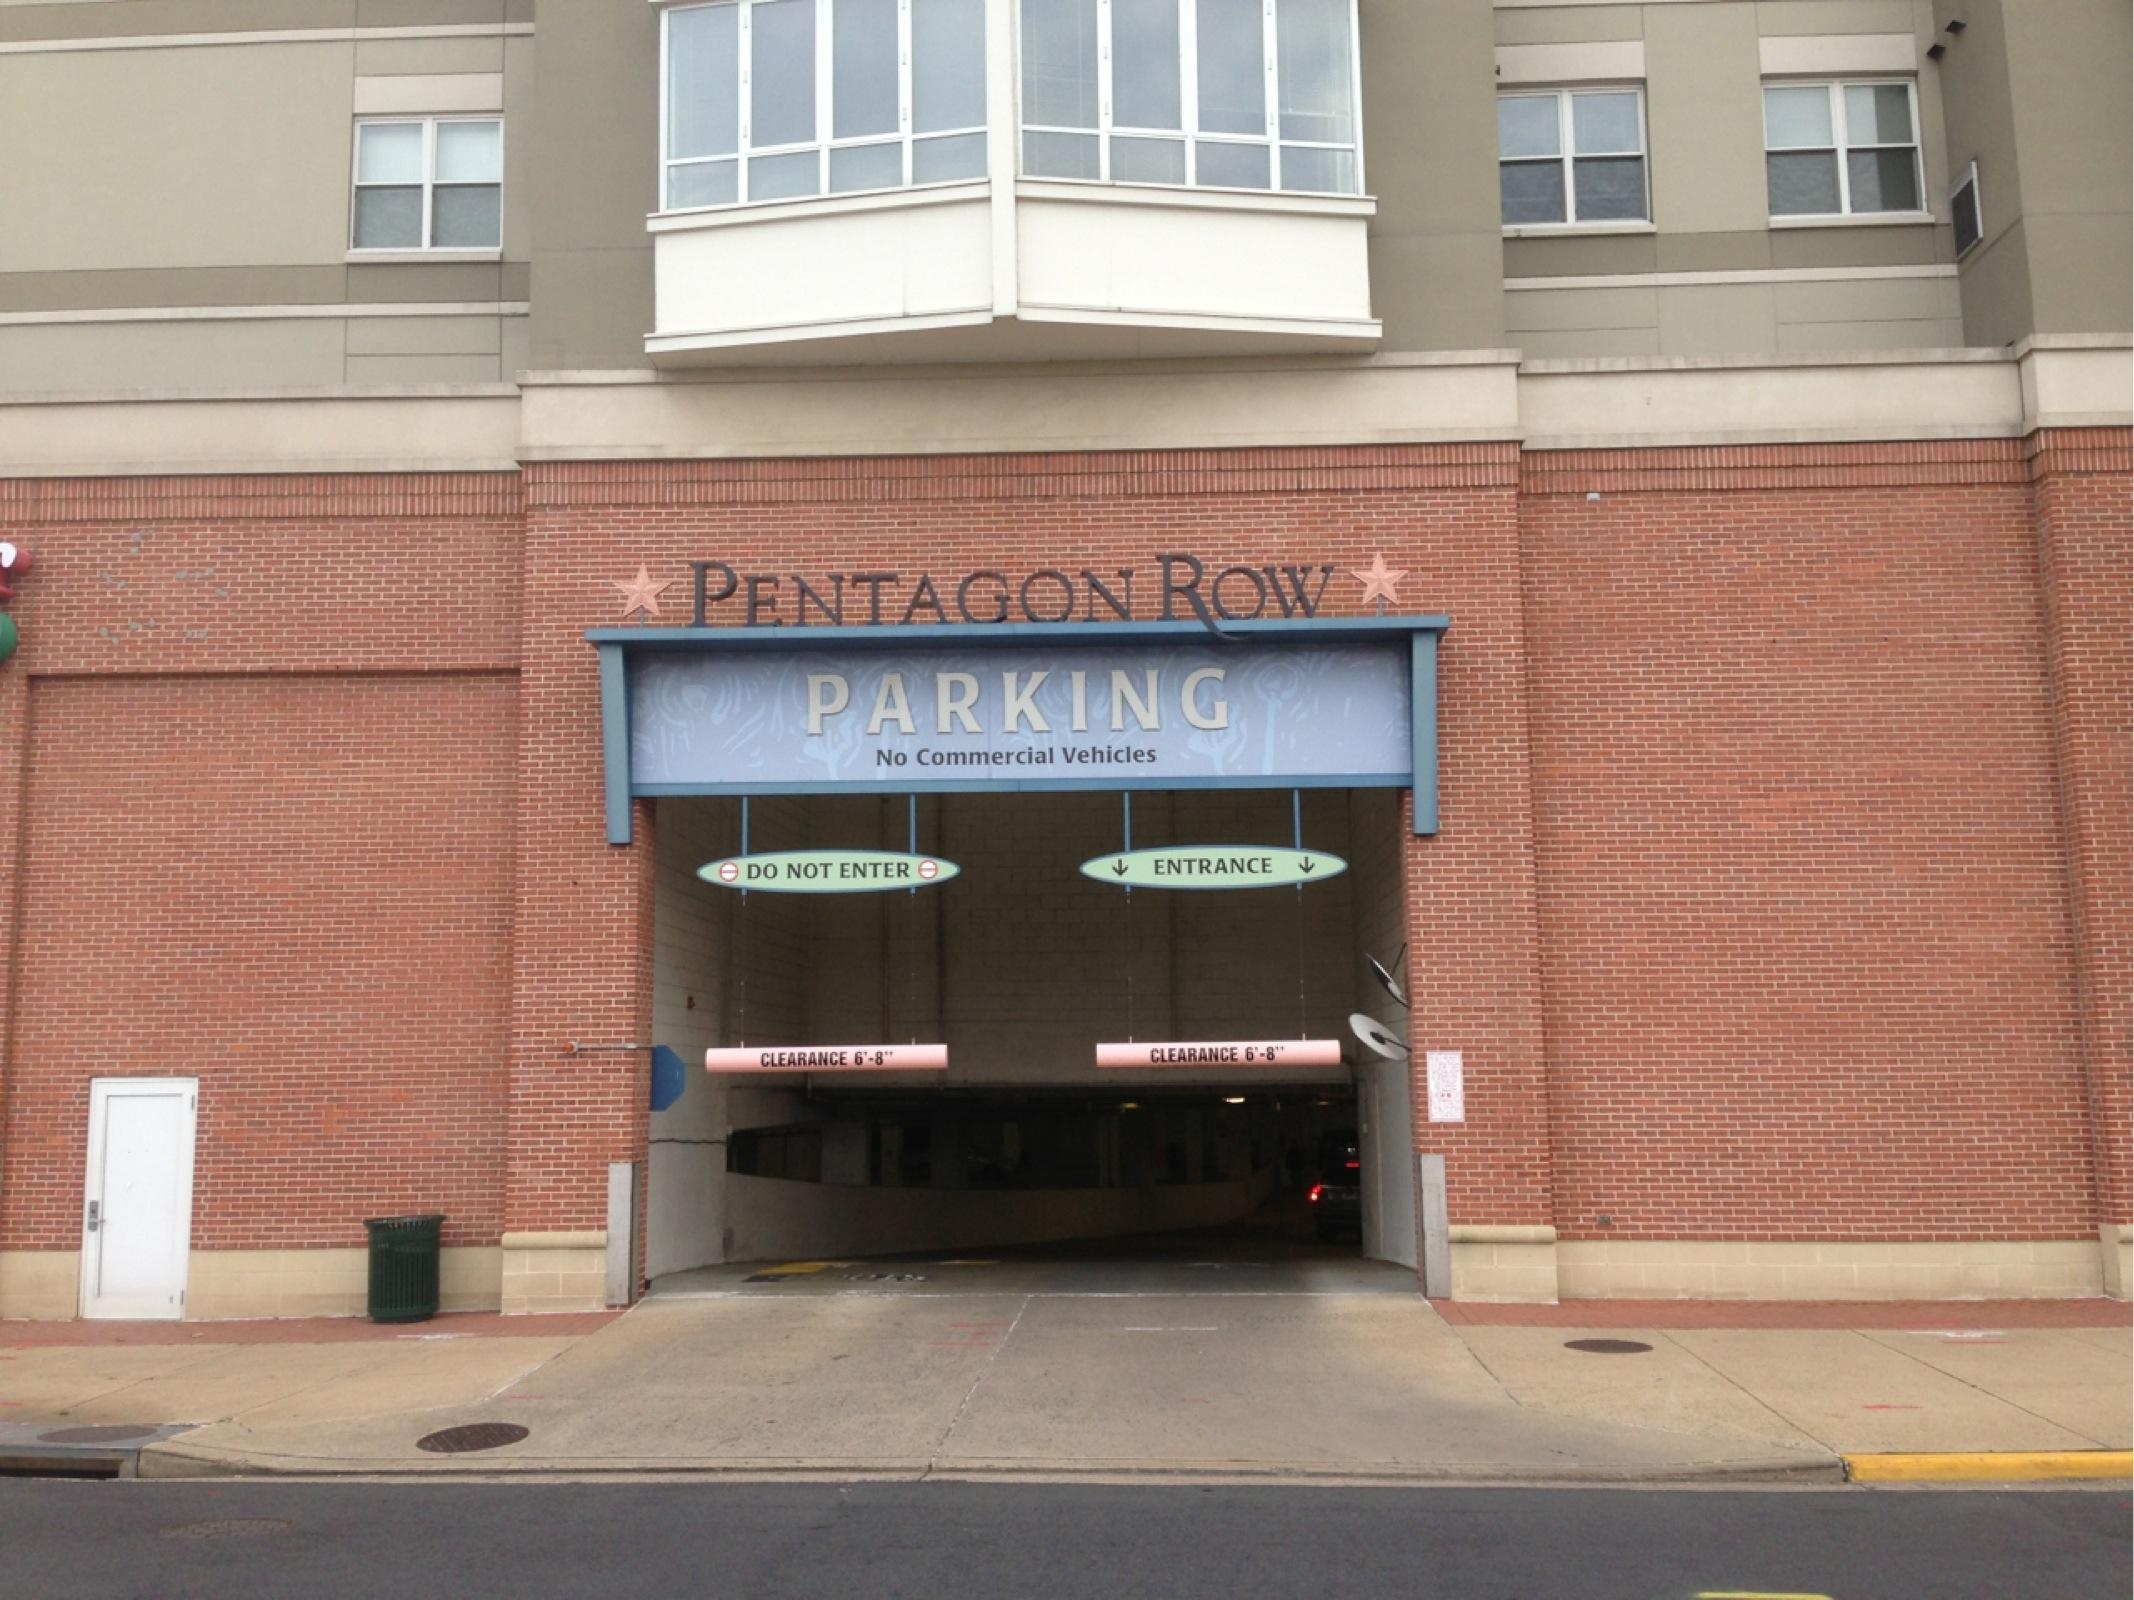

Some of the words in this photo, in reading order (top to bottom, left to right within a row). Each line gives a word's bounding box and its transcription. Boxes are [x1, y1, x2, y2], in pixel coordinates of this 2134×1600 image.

[689, 559, 1134, 628] PENTAGON
[1155, 554, 1334, 641] ROW
[806, 667, 1230, 736] PARKING
[875, 749, 908, 767] No
[916, 746, 1054, 767] Commercial
[1061, 745, 1157, 765] Vehicles
[746, 863, 778, 880] DO
[786, 862, 834, 879] NOT
[840, 862, 910, 879] ENTER
[1153, 857, 1274, 876] ENTRANCE
[760, 1051, 849, 1068] CLEARANCE
[1150, 1046, 1239, 1063] CLEARANCE
